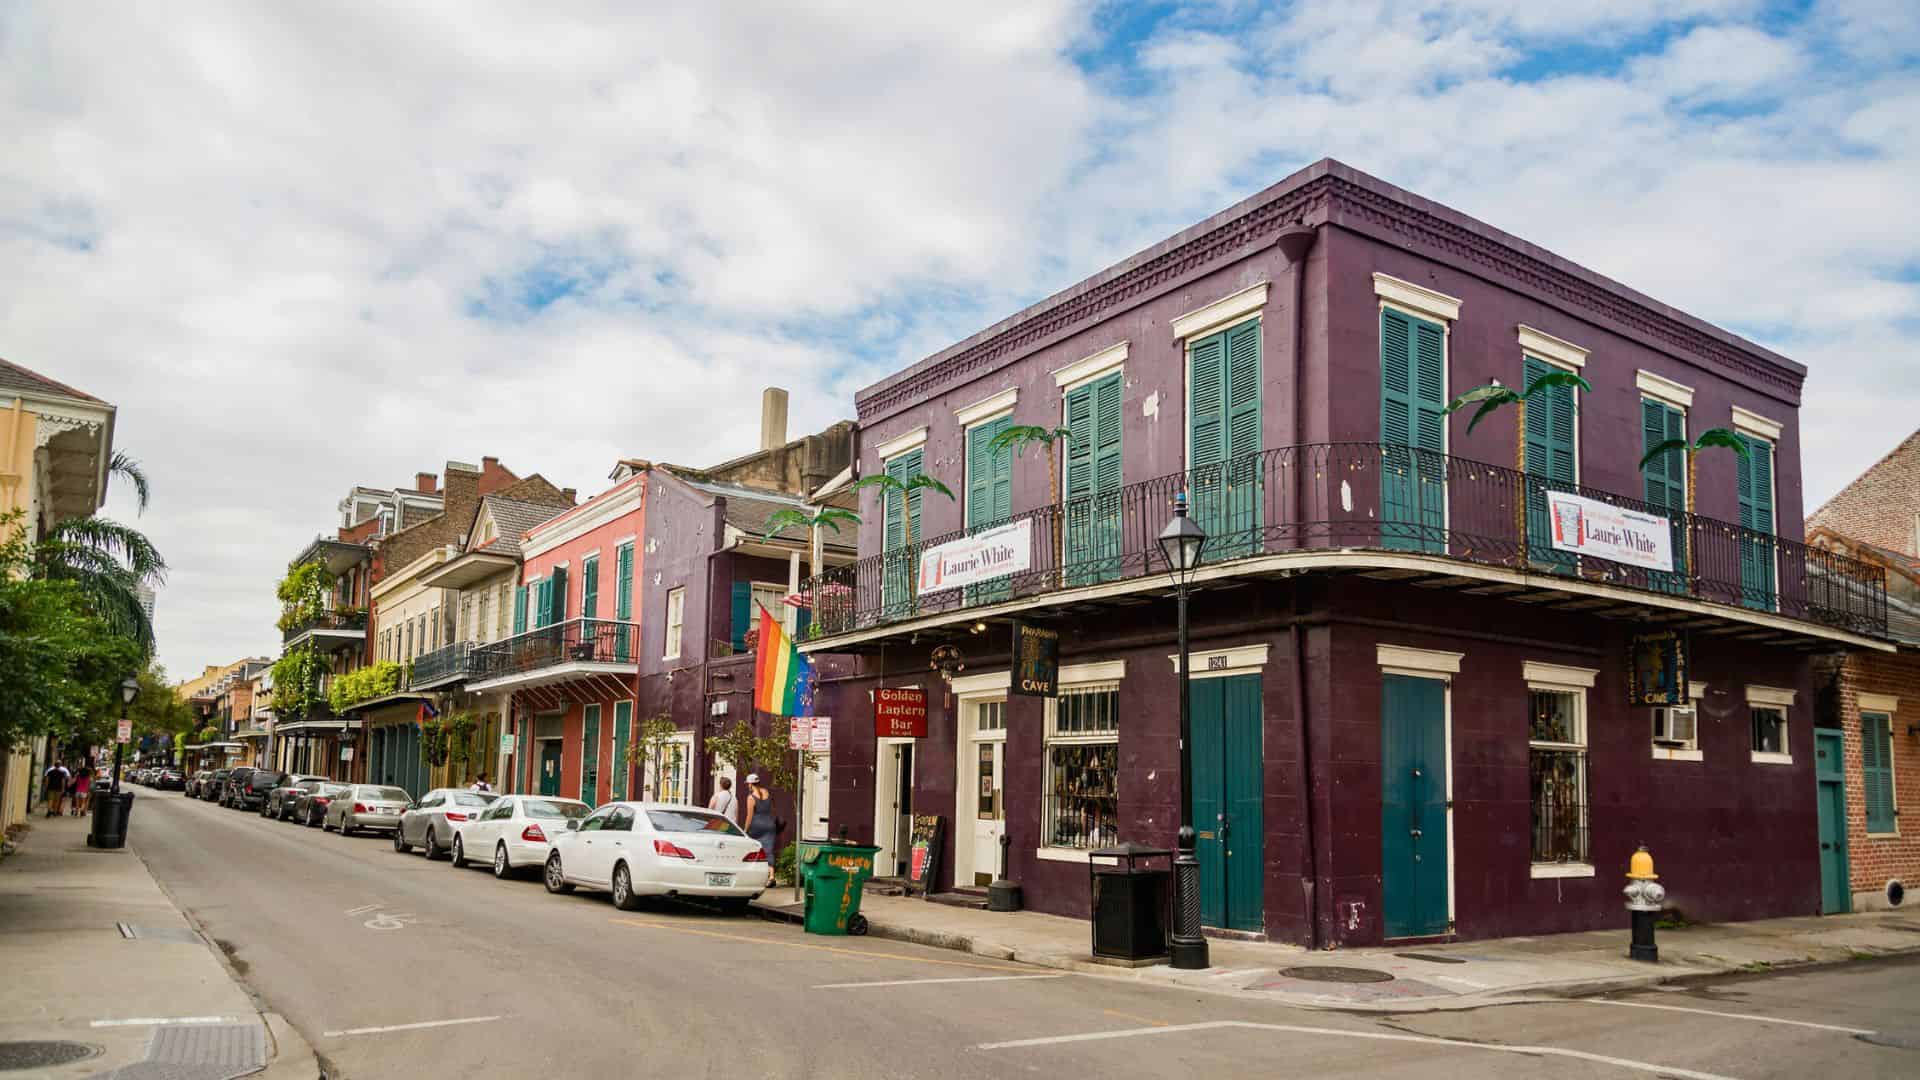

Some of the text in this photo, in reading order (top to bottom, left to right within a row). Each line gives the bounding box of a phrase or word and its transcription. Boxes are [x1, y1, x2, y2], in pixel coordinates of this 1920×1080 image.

[1585, 519, 1656, 554] Laurie White
[943, 553, 979, 577] Laurie
[980, 543, 1014, 567] White
[1021, 680, 1049, 692] CAVE
[880, 689, 923, 703] Golden
[878, 703, 926, 717] Lantern
[890, 718, 913, 729] Bar
